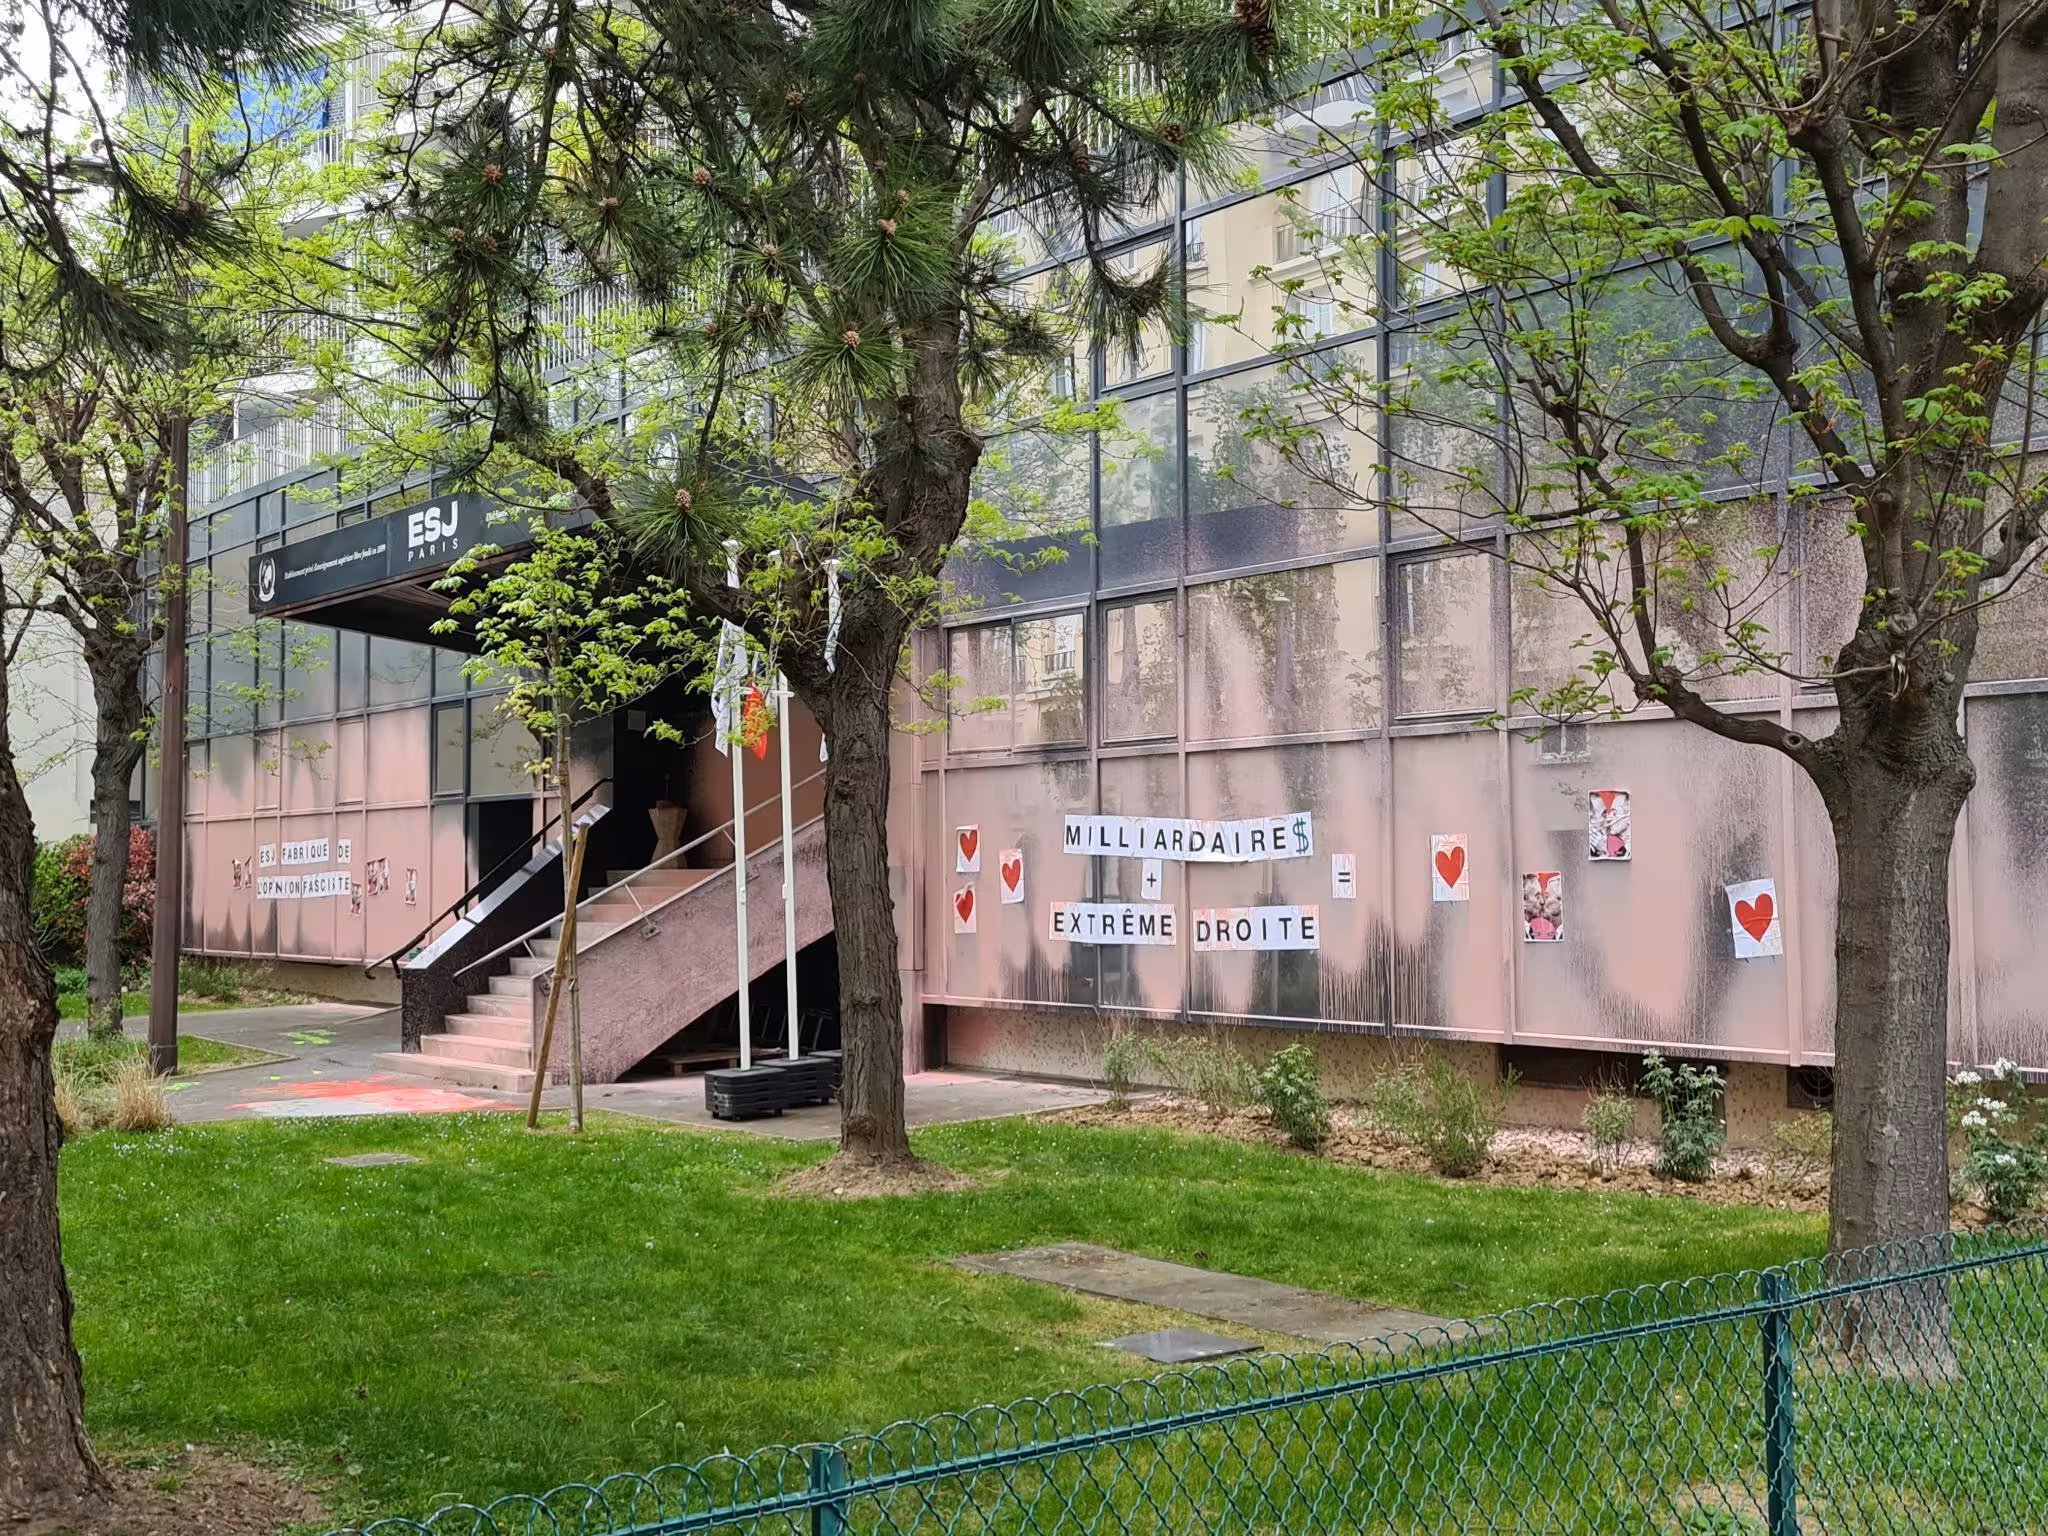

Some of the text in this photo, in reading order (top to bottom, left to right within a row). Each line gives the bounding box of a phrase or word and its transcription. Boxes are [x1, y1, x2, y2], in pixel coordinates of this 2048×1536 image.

[407, 500, 459, 549] ESJ
[408, 538, 459, 563] PARIS
[1065, 816, 1310, 855] MILLIARDAIRE$
[260, 844, 349, 863] ESJ FABRIQUE DE
[257, 880, 300, 894] L'OPNION
[1053, 908, 1316, 943] EXTRÊME DROITE
